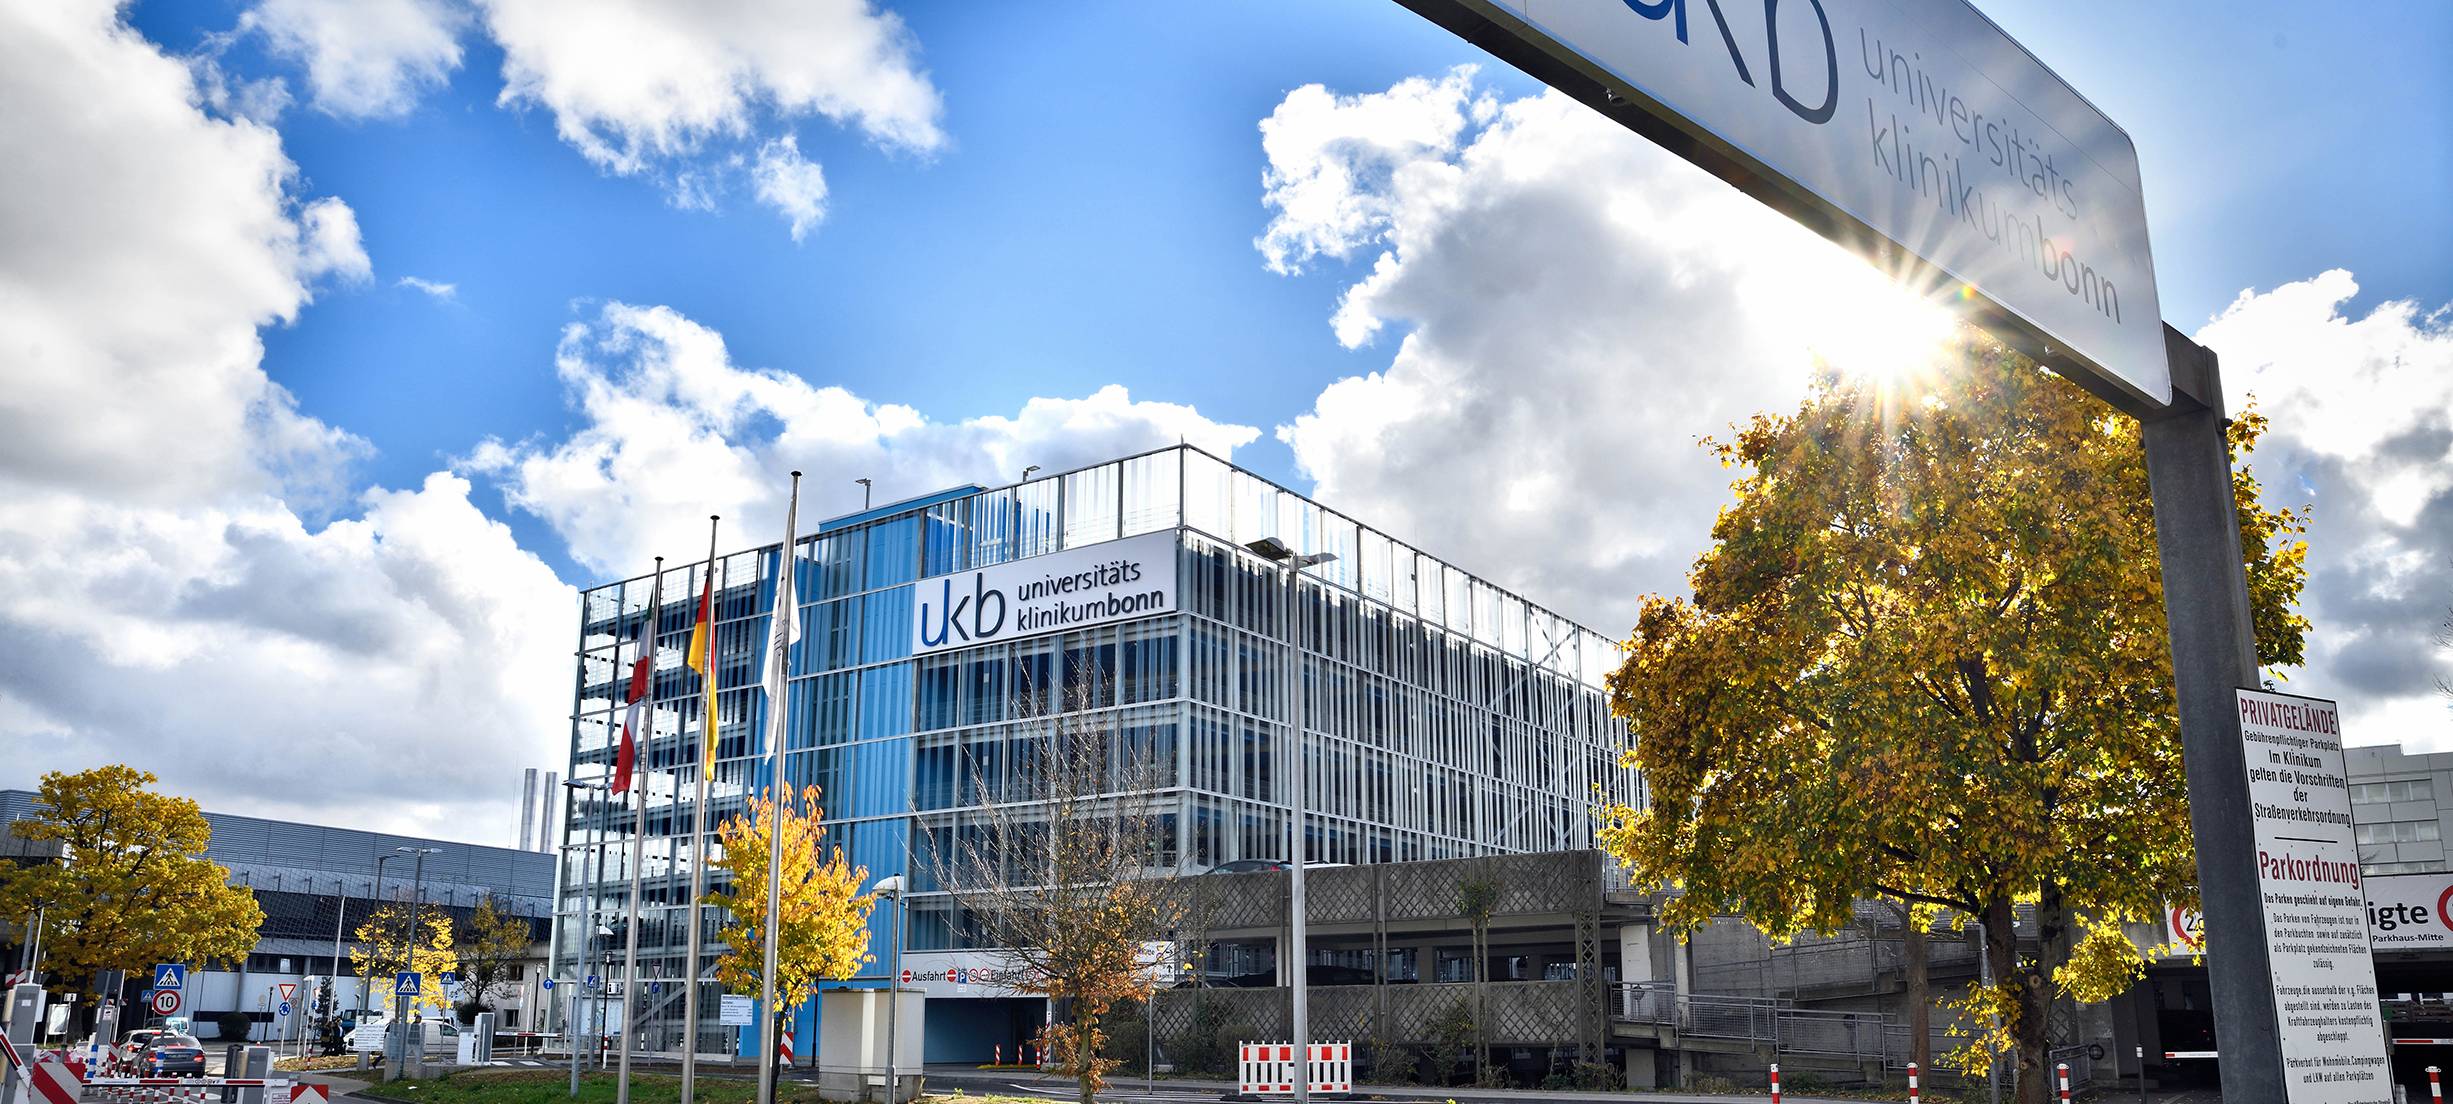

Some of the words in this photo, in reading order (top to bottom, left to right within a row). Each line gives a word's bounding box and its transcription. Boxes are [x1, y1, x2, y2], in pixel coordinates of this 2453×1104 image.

[1860, 26, 2077, 220] universitäts
[1868, 97, 2121, 325] klinikumbonn
[1018, 560, 1141, 601] universitäts
[922, 572, 1006, 647] ukb
[1017, 589, 1164, 631] klinikumbonn
[2240, 697, 2337, 735] PRIVATGELÄNDE
[2244, 729, 2309, 750] Gebührenpflichtiger
[2310, 738, 2340, 752] Parkplatz
[2268, 750, 2281, 764] Im
[2283, 751, 2322, 768] Klinikum
[2250, 767, 2277, 783] gelten
[2280, 769, 2293, 784] die
[2294, 770, 2346, 789] Vorschriften
[2293, 787, 2308, 802] der
[2254, 802, 2351, 829] Straßenverkehrsordnung
[2259, 850, 2360, 890] Parkordnung
[2264, 892, 2274, 904] Das
[2275, 892, 2293, 905] Parken
[2294, 894, 2319, 907] geschieht
[2319, 896, 2328, 906] auf
[2328, 895, 2344, 908] eigene
[2273, 912, 2282, 923] Das
[2283, 912, 2300, 924] Parken
[2301, 915, 2310, 924] von
[2311, 913, 2337, 926] Fahrzeugen
[2274, 928, 2283, 938] den
[2331, 929, 2339, 939] auf
[2372, 933, 2444, 942] Parkhaus-Mitte
[2273, 943, 2282, 953] als
[2282, 942, 2306, 955] Parkplatz
[911, 971, 947, 982] Ausfahrt
[159, 996, 174, 1009] 10
